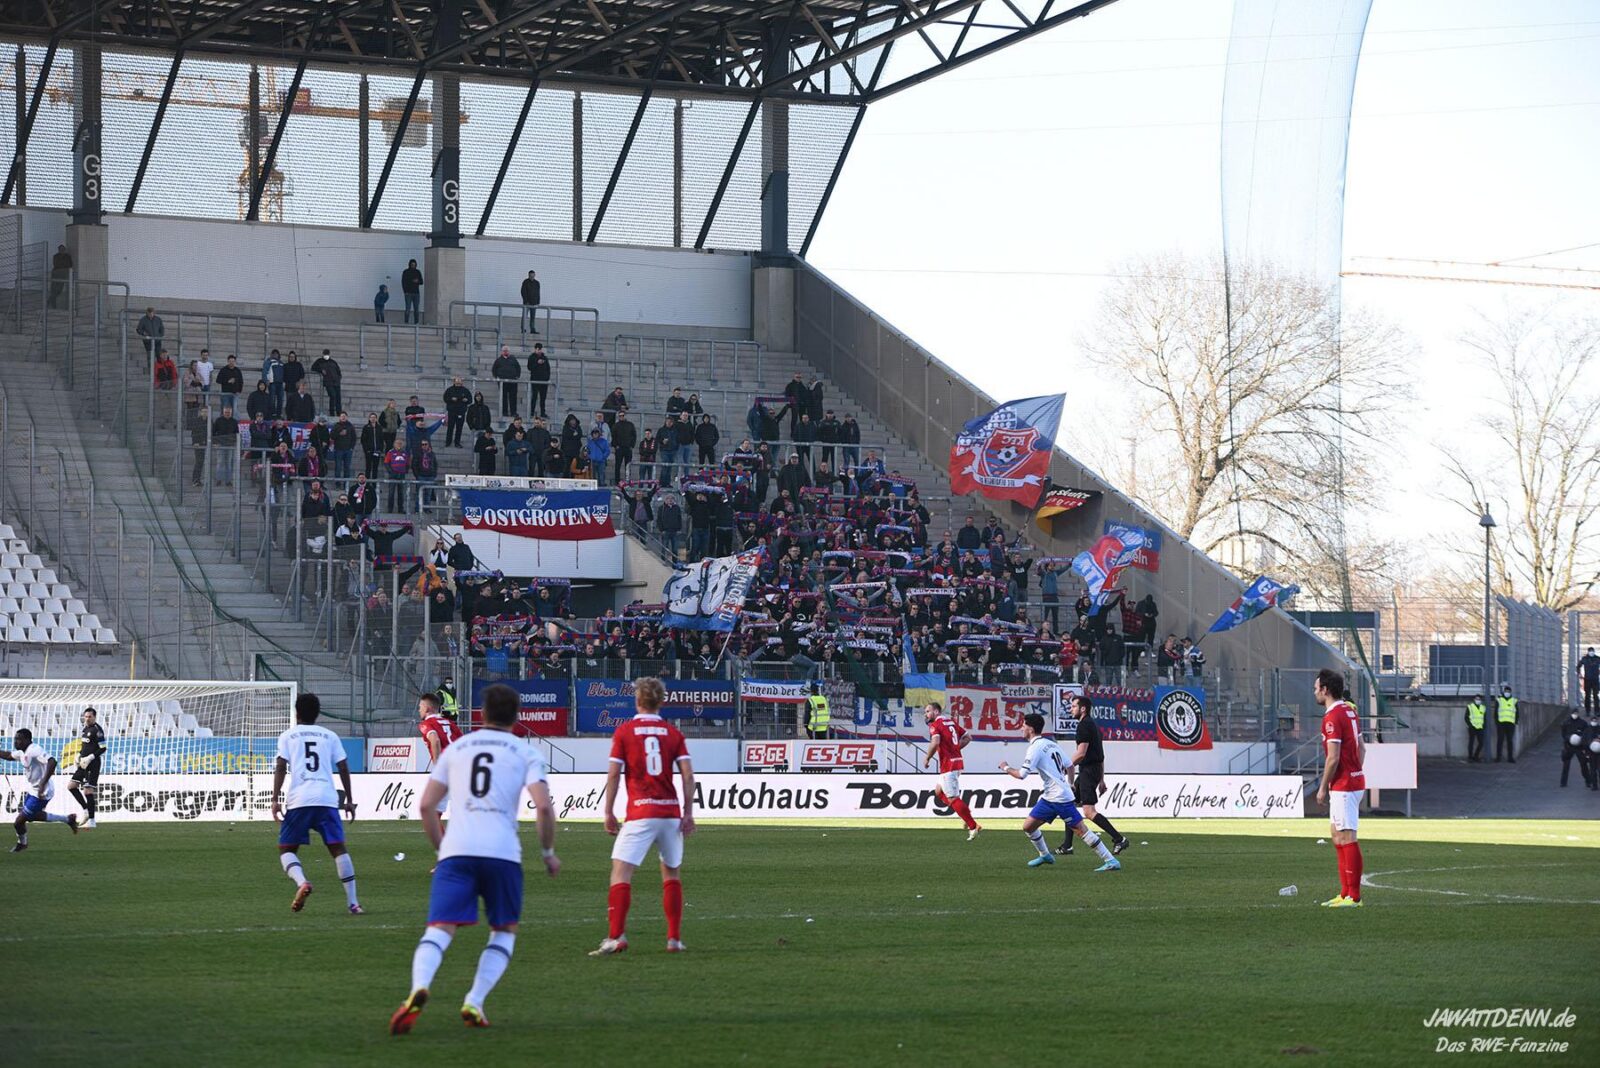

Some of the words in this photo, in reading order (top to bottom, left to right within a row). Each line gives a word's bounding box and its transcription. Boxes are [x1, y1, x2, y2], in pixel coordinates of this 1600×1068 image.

[484, 506, 592, 527] OSTGROTEN
[520, 693, 557, 704] RDINGER
[781, 685, 797, 696] der
[518, 711, 557, 721] ALUNKEN
[949, 725, 958, 746] 3
[304, 741, 320, 773] 5
[375, 746, 410, 757] TRANSPORTE
[644, 736, 663, 777] 8
[470, 752, 495, 799] 6
[93, 783, 352, 820] Borgma
[375, 781, 414, 812] Mit
[691, 781, 830, 810] Autohaus
[845, 782, 1080, 815] Borgman
[1104, 782, 1138, 811] Mit
[1142, 793, 1169, 809] uns
[1172, 784, 1228, 818] fahren
[1235, 783, 1259, 809] Sie
[1263, 784, 1303, 819] gut!
